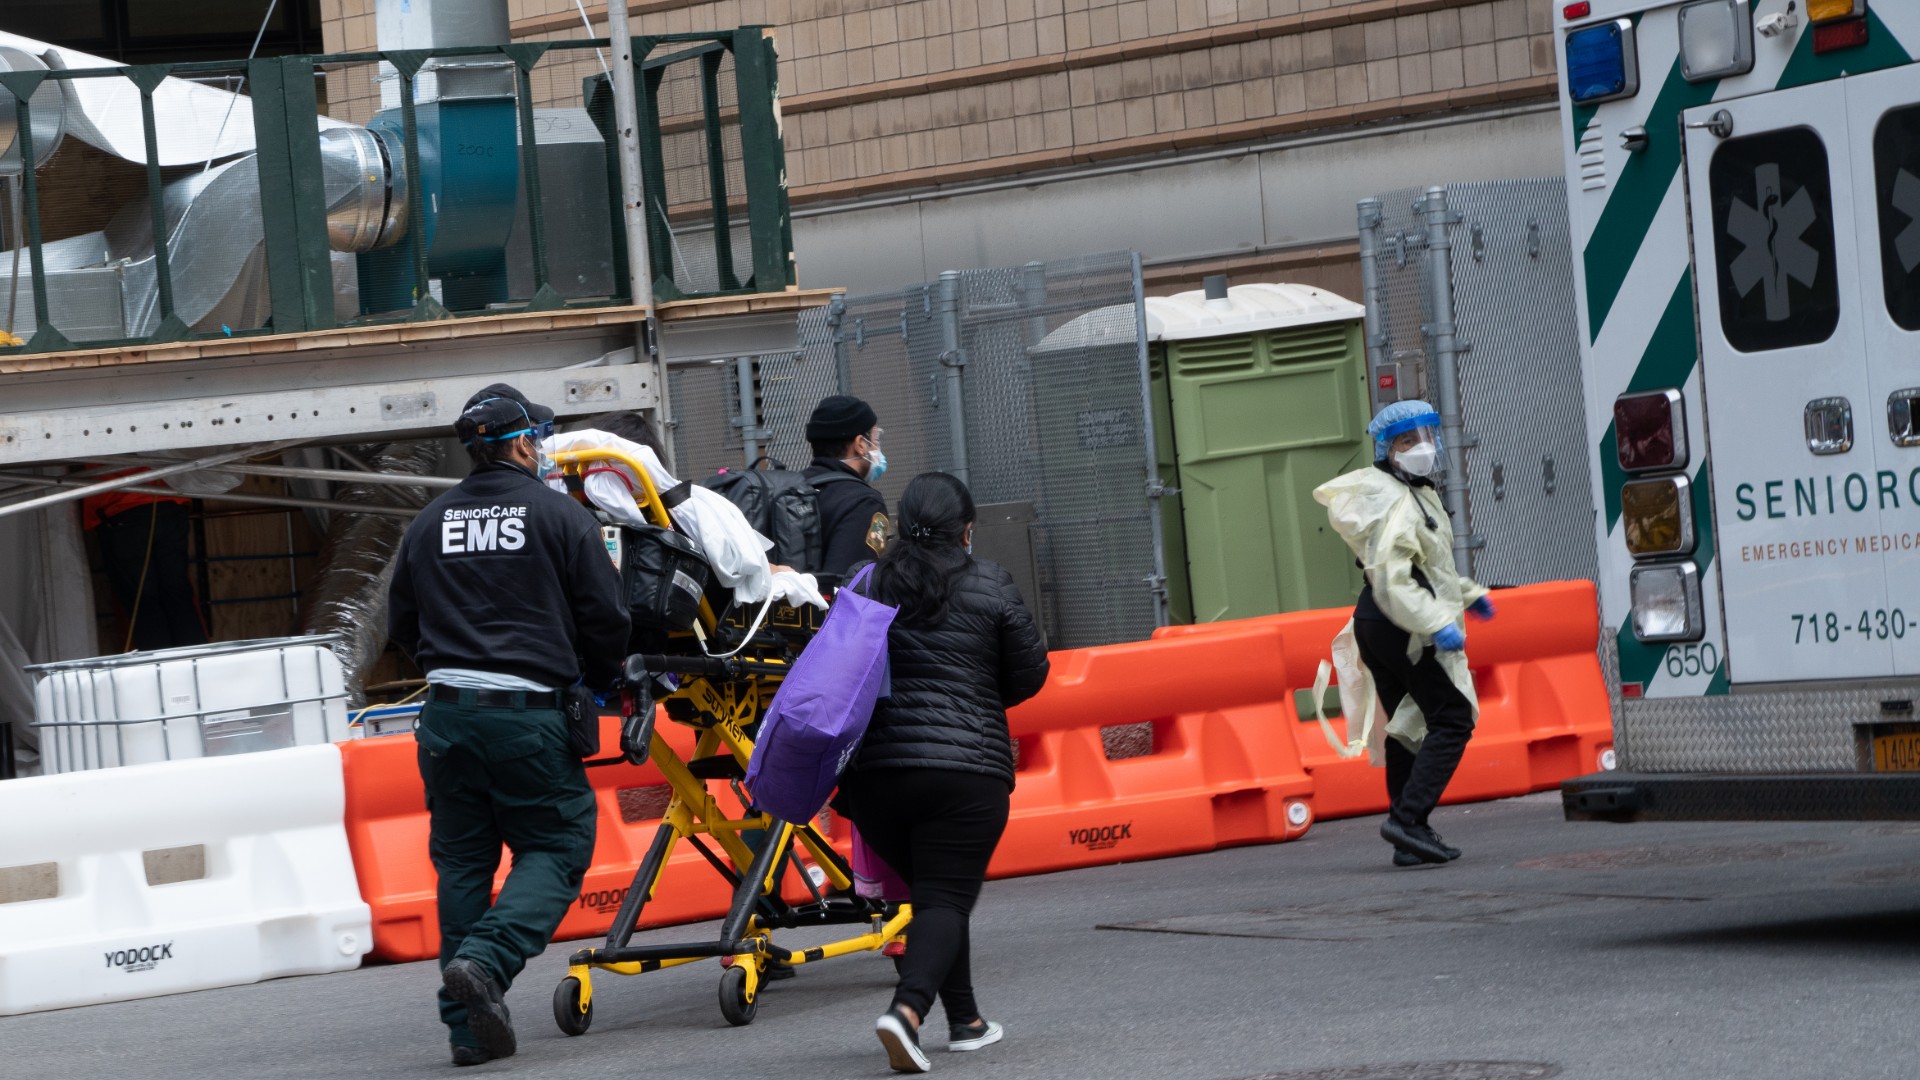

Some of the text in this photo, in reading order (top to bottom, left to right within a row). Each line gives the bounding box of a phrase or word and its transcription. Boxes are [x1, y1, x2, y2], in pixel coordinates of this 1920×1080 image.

[441, 517, 526, 555] EMS
[1742, 537, 1848, 562] EMERGENCY
[1665, 642, 1718, 678] 650
[702, 687, 746, 743] stryker
[1069, 823, 1132, 845] YODOCK
[104, 943, 172, 968] YODOCK
